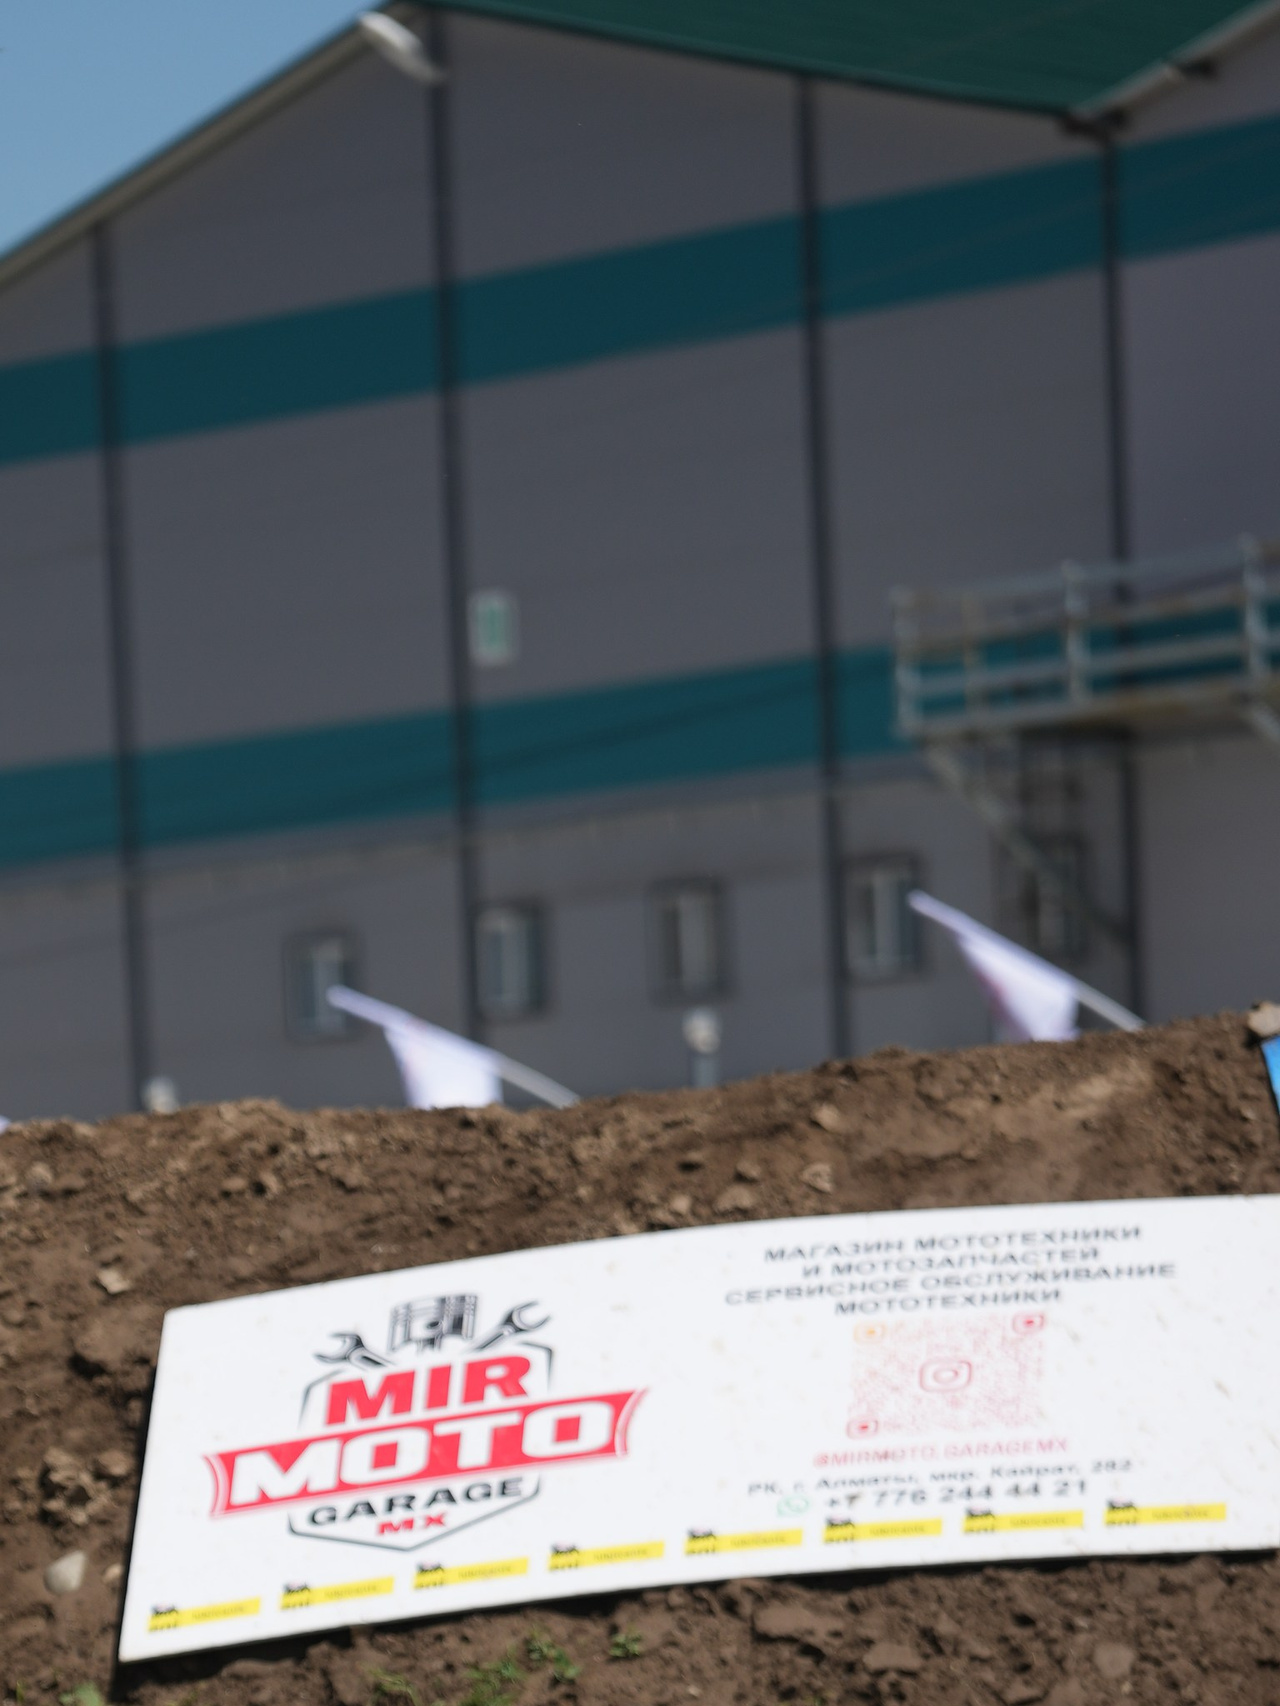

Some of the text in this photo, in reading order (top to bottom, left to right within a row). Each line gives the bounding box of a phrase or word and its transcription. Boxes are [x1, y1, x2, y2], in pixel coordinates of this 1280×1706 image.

[764, 1225, 1141, 1263] МАГАЗИН МОТОТЕХНИКИ
[801, 1246, 1100, 1278] И МОТОЗАПЧАСТЕЙ
[725, 1263, 1176, 1305] СЕРВИСНОЕ ОБСЛУЖИВАНИЕ
[835, 1288, 1061, 1314] МОТОТЕХНИКИ
[326, 1355, 531, 1425] MIR
[229, 1401, 614, 1506] MOTO
[309, 1476, 523, 1527] GARAGE
[376, 1513, 448, 1535] MX
